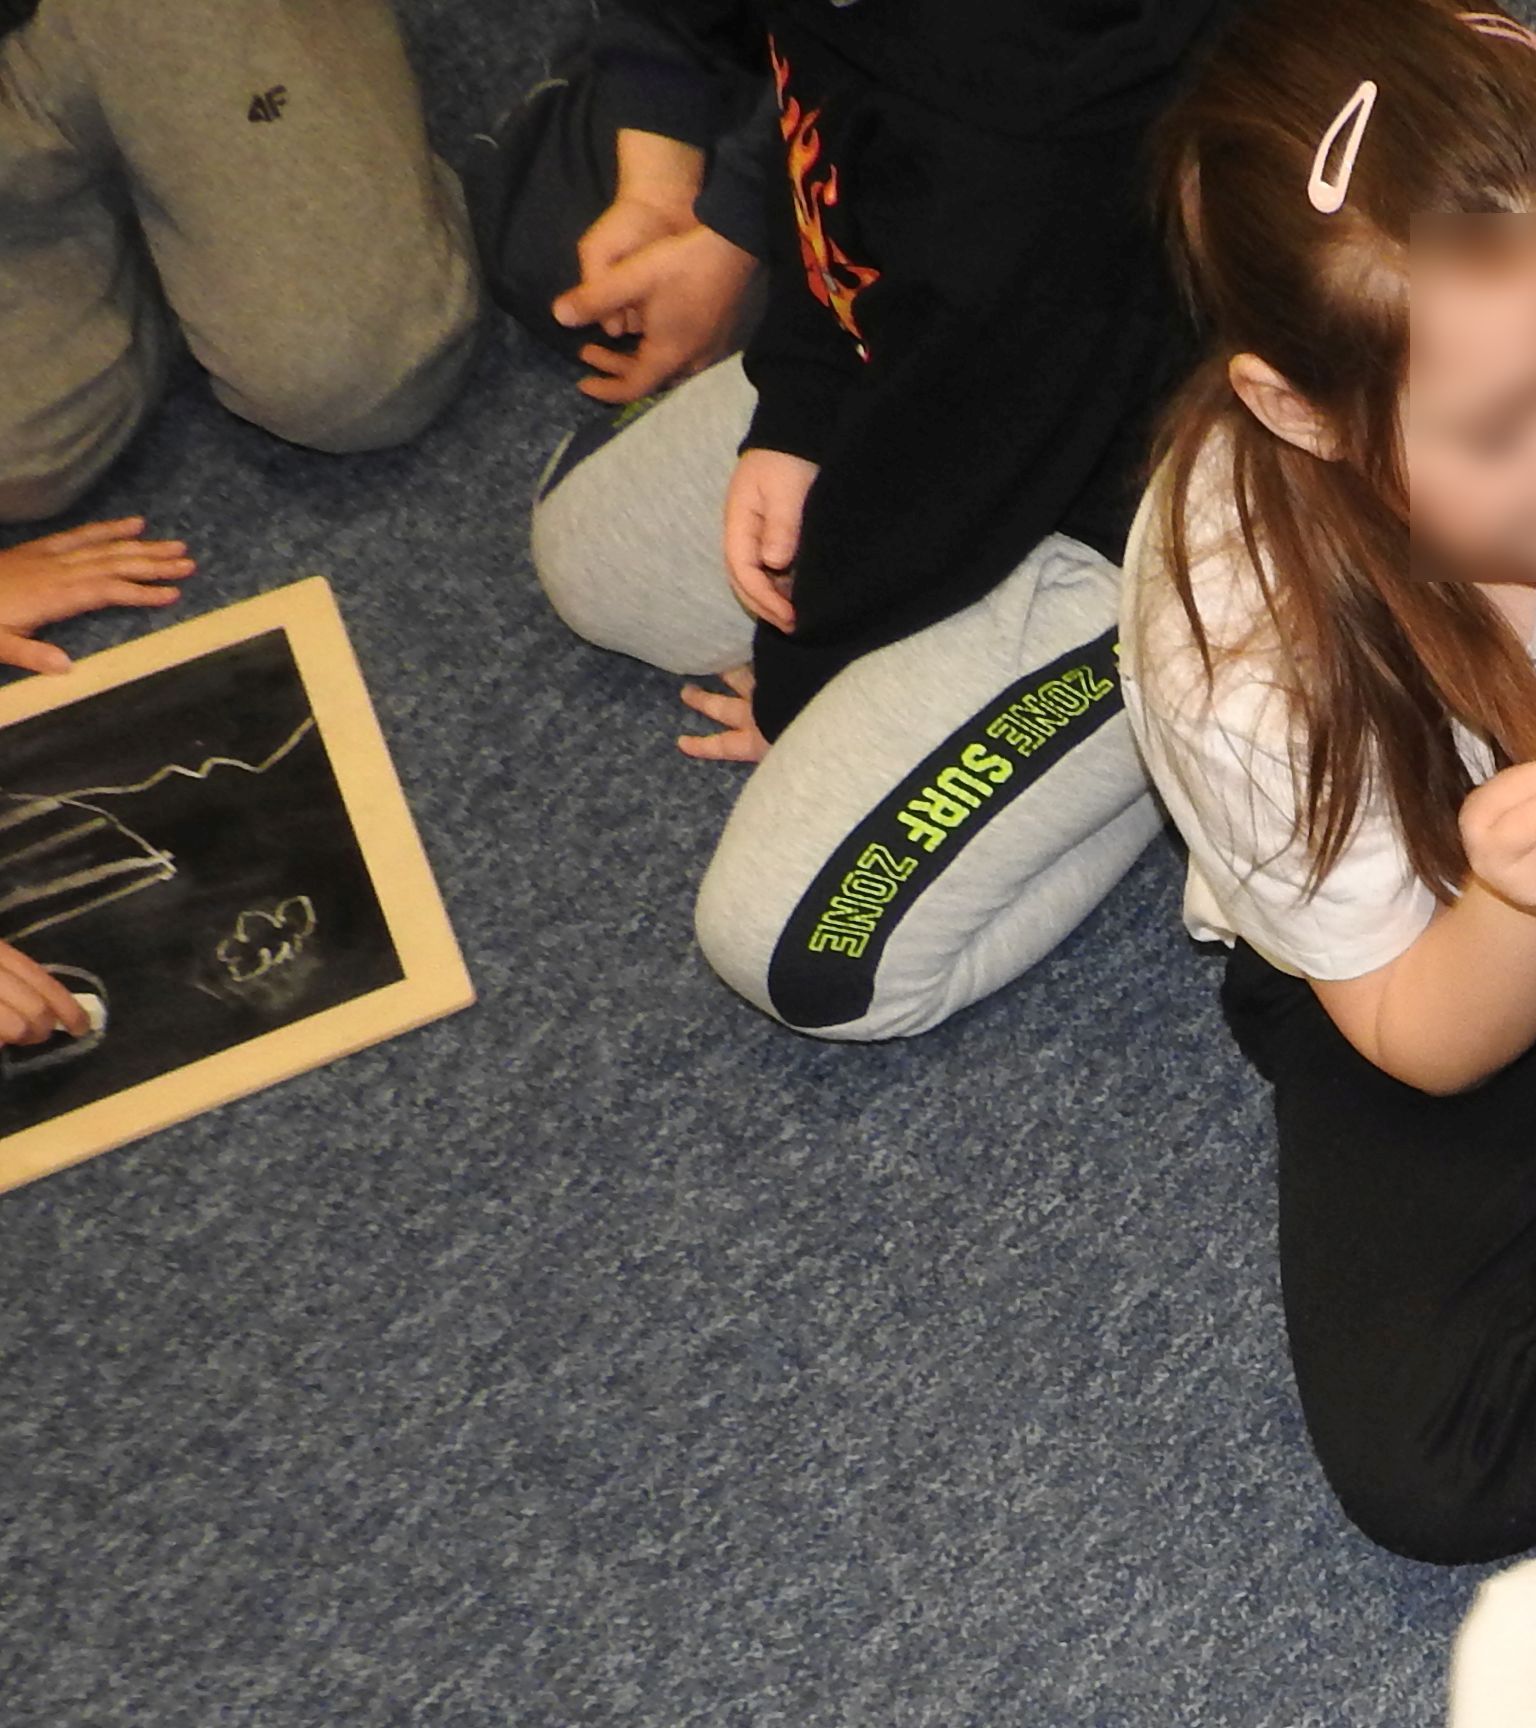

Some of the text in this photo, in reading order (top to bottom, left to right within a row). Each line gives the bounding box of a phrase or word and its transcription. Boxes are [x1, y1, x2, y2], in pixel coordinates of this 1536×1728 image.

[807, 665, 1113, 958] ZONE SURF ZONE
